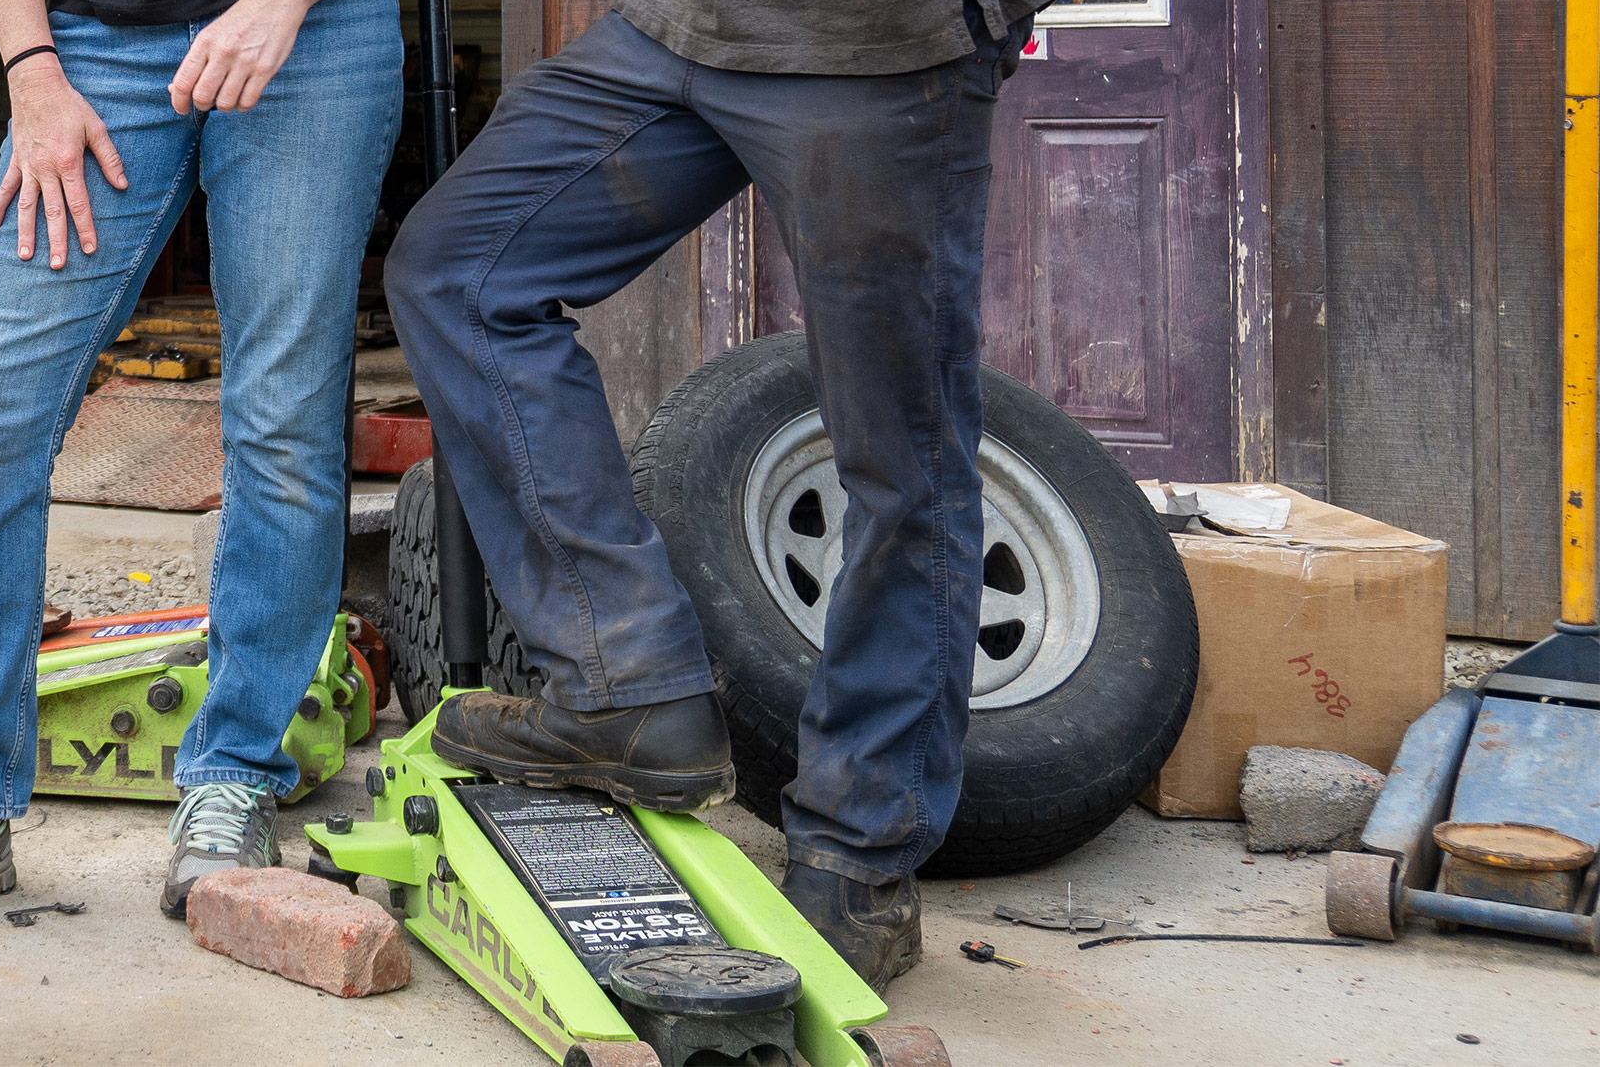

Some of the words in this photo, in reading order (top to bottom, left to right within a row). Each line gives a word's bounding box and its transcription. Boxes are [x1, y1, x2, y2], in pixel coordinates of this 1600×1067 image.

[591, 910, 619, 918] JACK
[646, 913, 699, 926] 3.5
[567, 917, 643, 932] TON
[582, 926, 708, 944] CARLYLE
